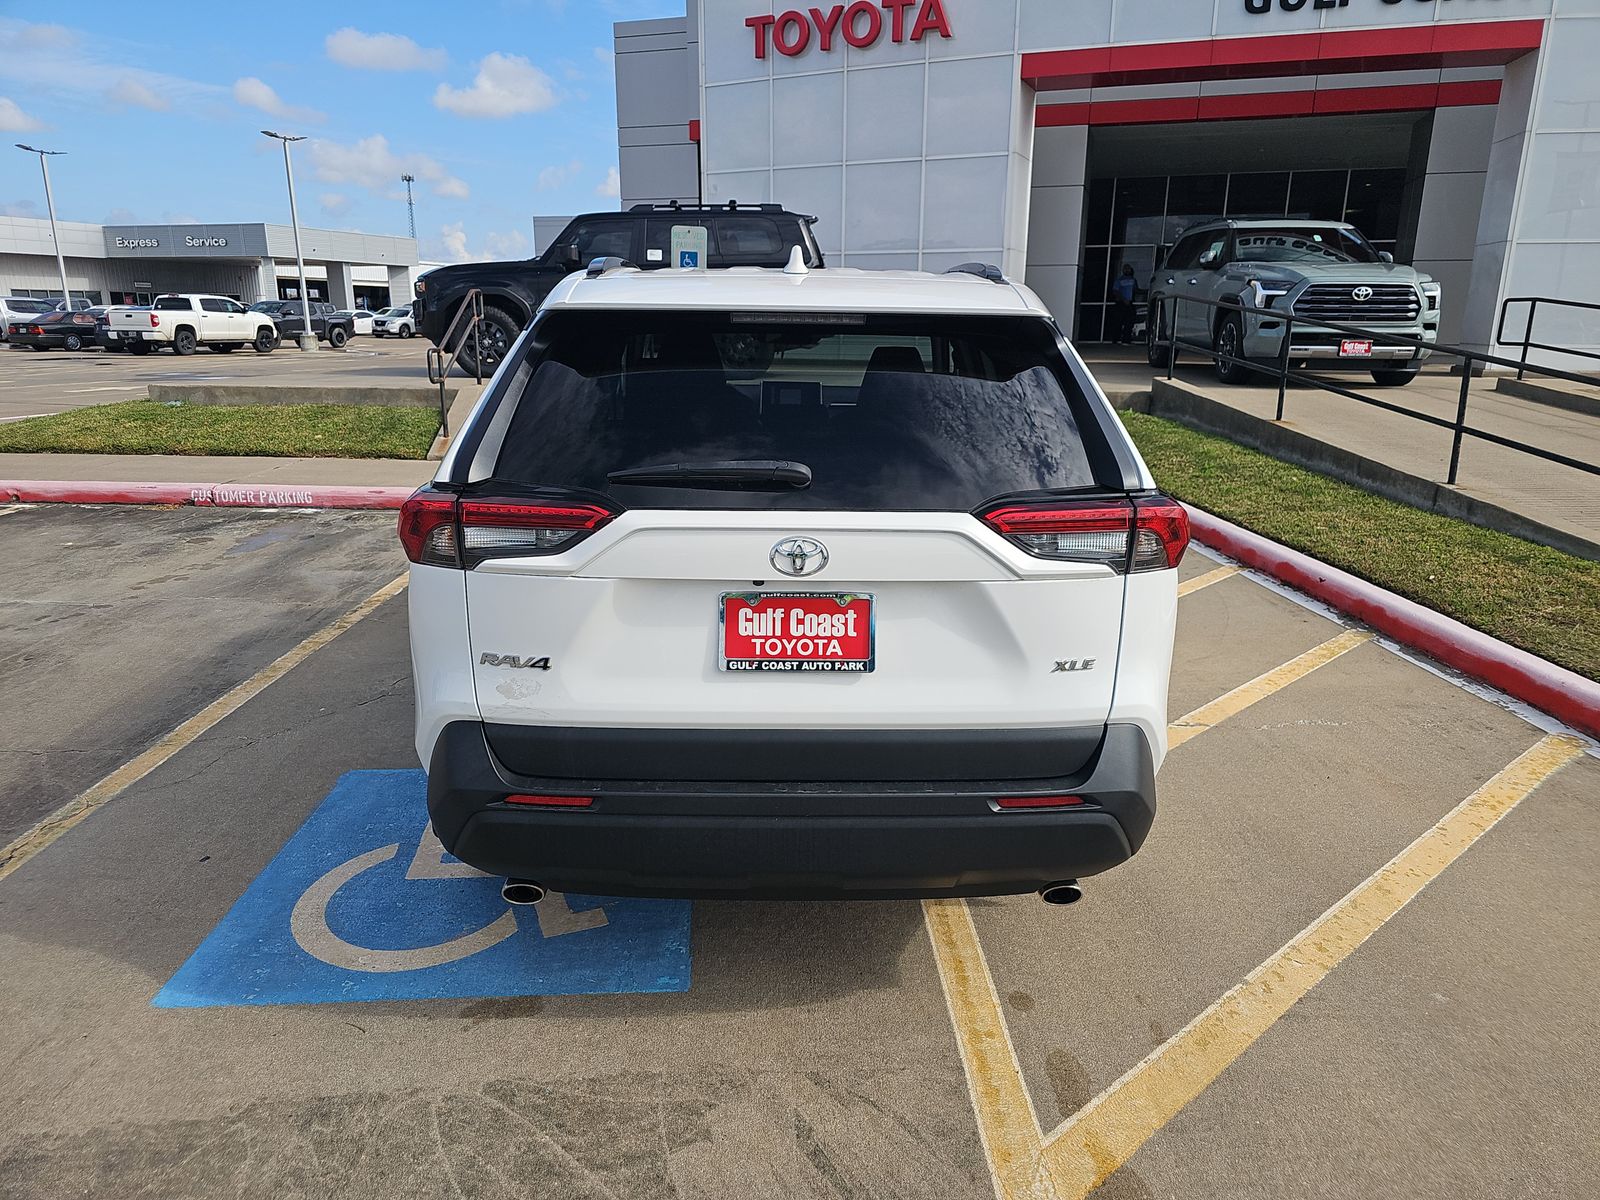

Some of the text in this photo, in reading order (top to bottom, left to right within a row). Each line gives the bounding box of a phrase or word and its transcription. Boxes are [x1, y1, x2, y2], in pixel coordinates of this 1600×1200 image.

[744, 0, 953, 60] TOYOTA
[115, 235, 227, 250] Express Service
[191, 489, 313, 504] CUSTOMER PARKING
[738, 607, 857, 637] Gulf Coast
[751, 638, 843, 656] TOYOTA
[480, 652, 552, 671] RAV4
[729, 660, 865, 671] GULF COAST AUTO PARK
[1049, 659, 1097, 674] XLE
